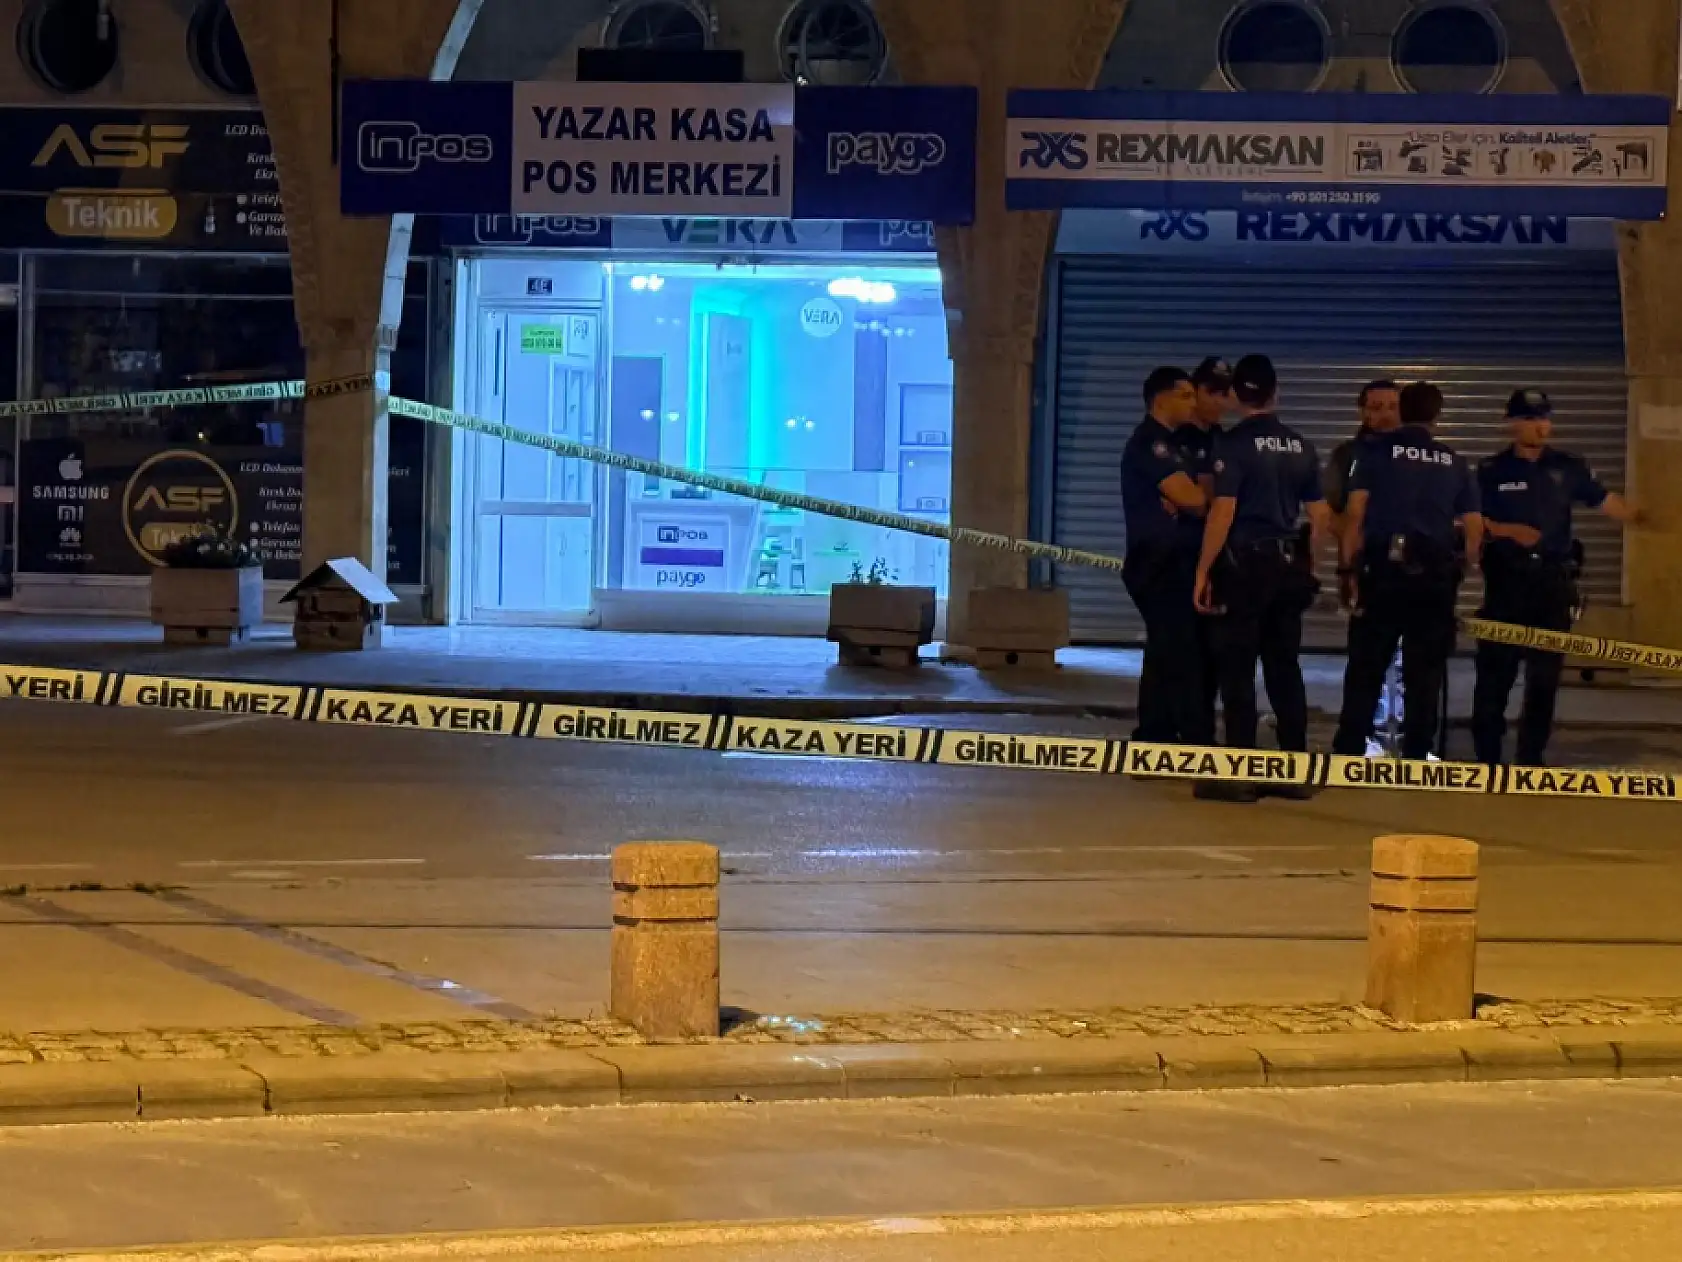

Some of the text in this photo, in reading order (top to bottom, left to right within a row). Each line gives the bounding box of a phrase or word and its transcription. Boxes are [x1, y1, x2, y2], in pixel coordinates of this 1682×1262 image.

[530, 105, 775, 142] YAZAR KASA
[30, 122, 190, 168] ASF
[1020, 131, 1324, 170] RXS REXMAKSAN
[520, 154, 781, 197] POS MERKEZİ
[60, 196, 160, 230] Teknik
[1236, 213, 1566, 243] REXMAKSAN
[32, 485, 109, 500] SAMSUNG
[133, 485, 226, 512] ASF
[656, 570, 706, 587] paygo
[6, 673, 1676, 797] YERİ GİRİLMEZ KAZA YERİ GİRİLMEZ KAZA YERİ GİRİLMEZ KAZA YERİ GİRİLMEZ KAZA YERİ
